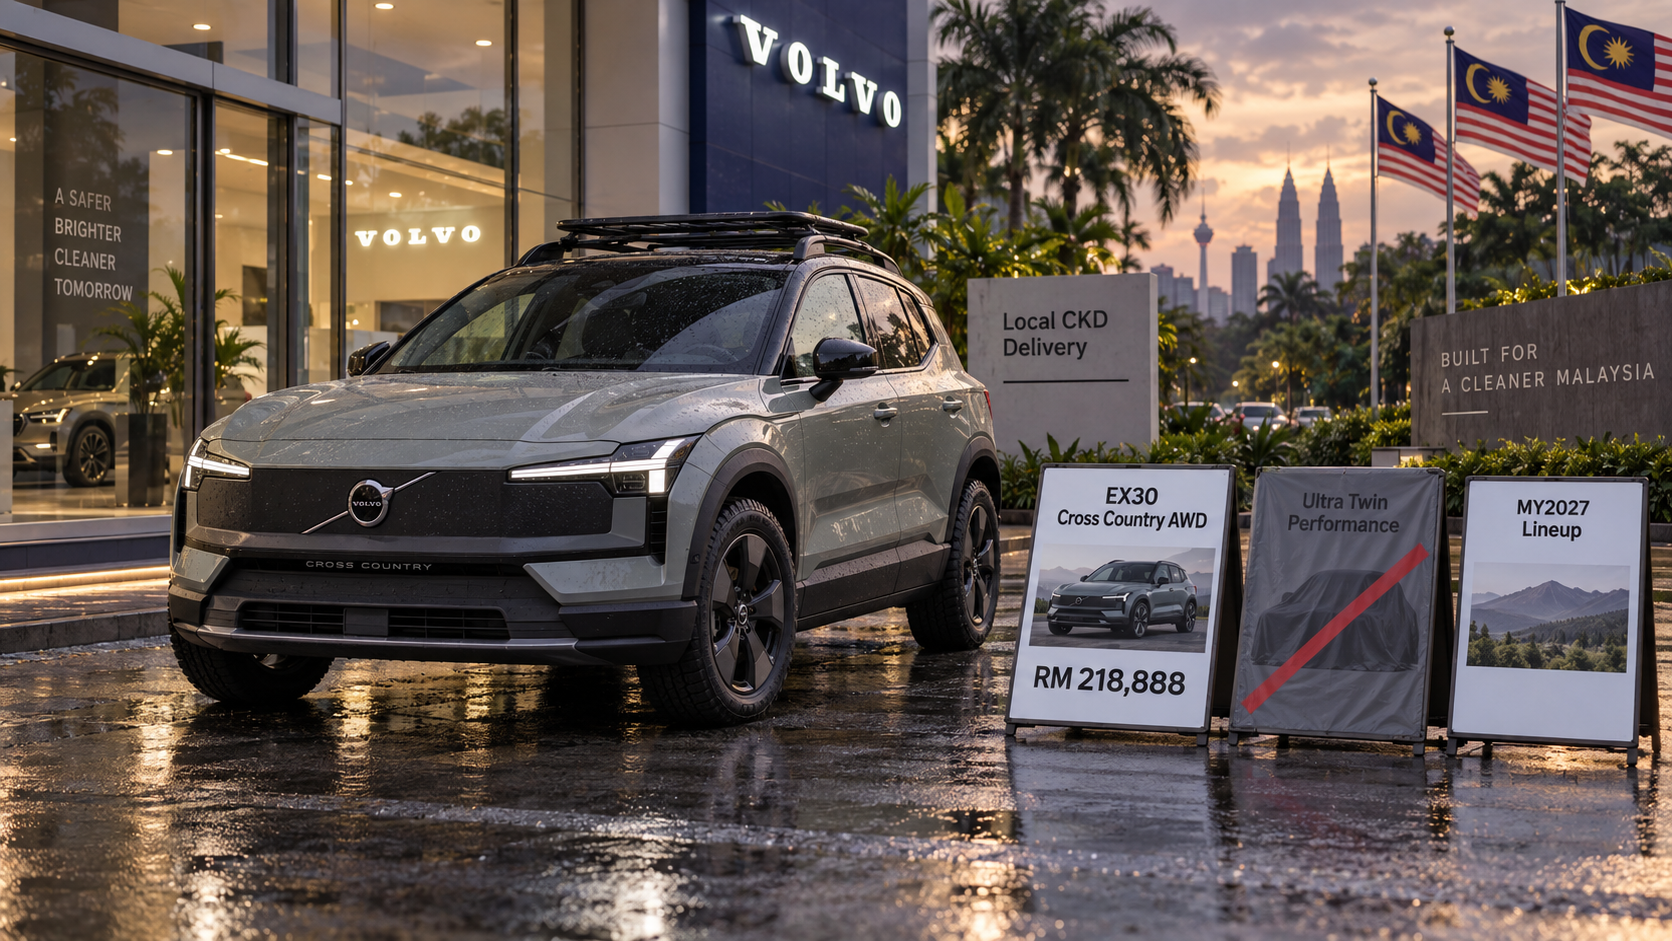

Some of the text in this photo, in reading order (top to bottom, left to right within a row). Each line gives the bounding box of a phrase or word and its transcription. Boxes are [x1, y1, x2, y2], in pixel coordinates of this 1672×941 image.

[734, 14, 902, 128] VOLVO
[55, 187, 112, 212] A SAFER
[54, 217, 122, 243] BRIGHTER
[354, 223, 482, 248] VOLVO
[54, 247, 116, 271] CLEANER
[54, 277, 133, 302] TOMORROW
[1003, 309, 1109, 331] Local CKD
[1003, 337, 1088, 361] Delivery
[1441, 343, 1538, 368] BUILT FOR
[1441, 362, 1655, 394] A CLEANER MALAYSIA
[1105, 486, 1159, 506] EX30
[1302, 492, 1388, 511] Ultra Twin
[1517, 499, 1590, 516] MY2027
[1057, 508, 1208, 532] Cross Country AWD
[1287, 514, 1400, 534] Performance
[1522, 520, 1583, 542] Lineup
[305, 560, 432, 571] CROSS COUNTRY
[1033, 665, 1186, 698] RM 218,888
